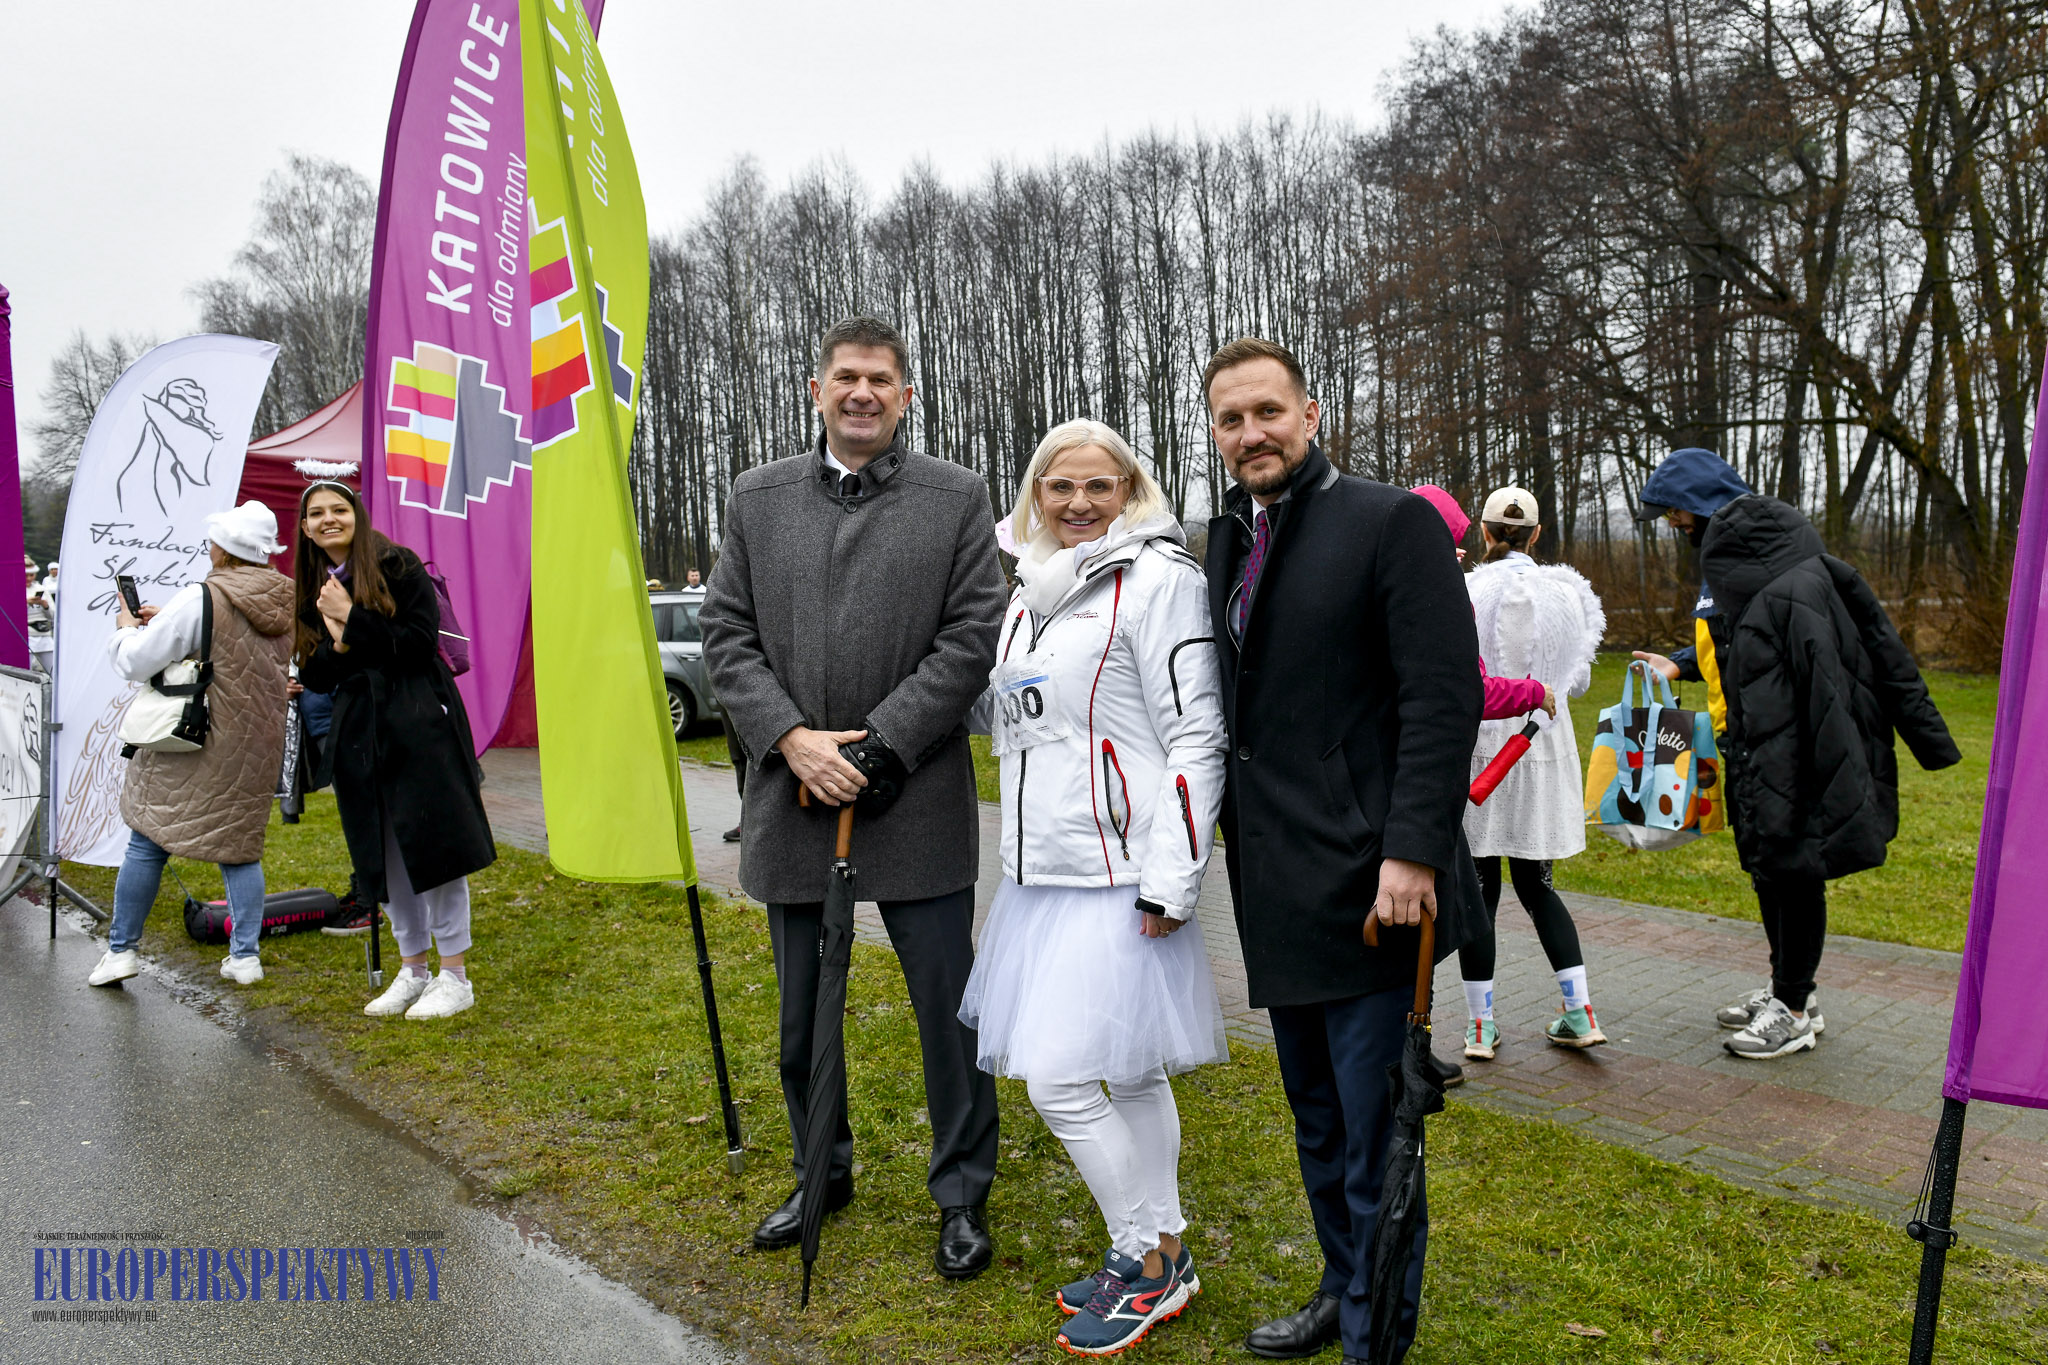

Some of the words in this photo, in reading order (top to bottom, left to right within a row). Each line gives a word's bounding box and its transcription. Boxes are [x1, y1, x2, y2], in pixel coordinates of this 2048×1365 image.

[426, 3, 509, 315] KATOWICE
[586, 139, 608, 206] dla
[487, 279, 515, 328] dla
